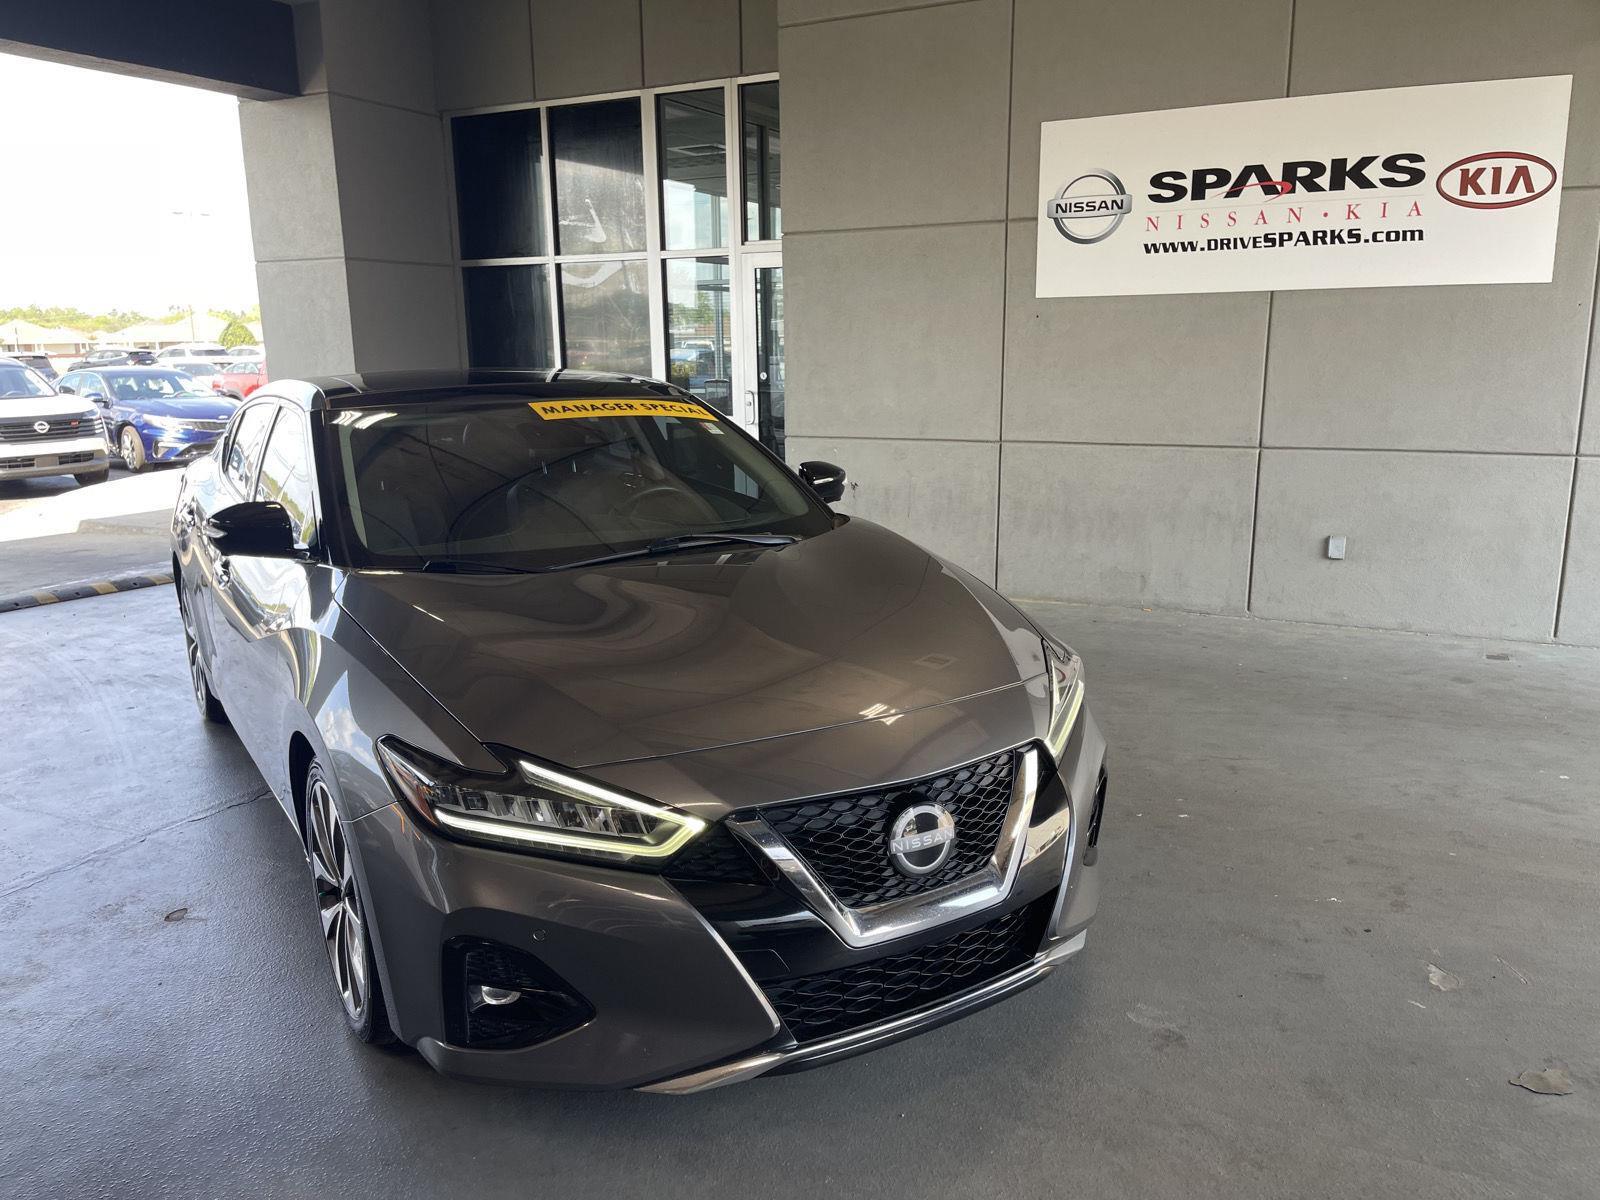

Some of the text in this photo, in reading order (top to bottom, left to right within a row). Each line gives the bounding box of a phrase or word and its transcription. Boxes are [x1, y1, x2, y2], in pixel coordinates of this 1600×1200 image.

[1147, 152, 1427, 204] SPARKS
[1458, 165, 1536, 197] KIA
[1055, 198, 1125, 214] NISSAN
[1145, 200, 1424, 232] NISSAN KIA
[540, 402, 709, 417] MANAGER SPECIAL
[891, 829, 954, 852] NISSAN
